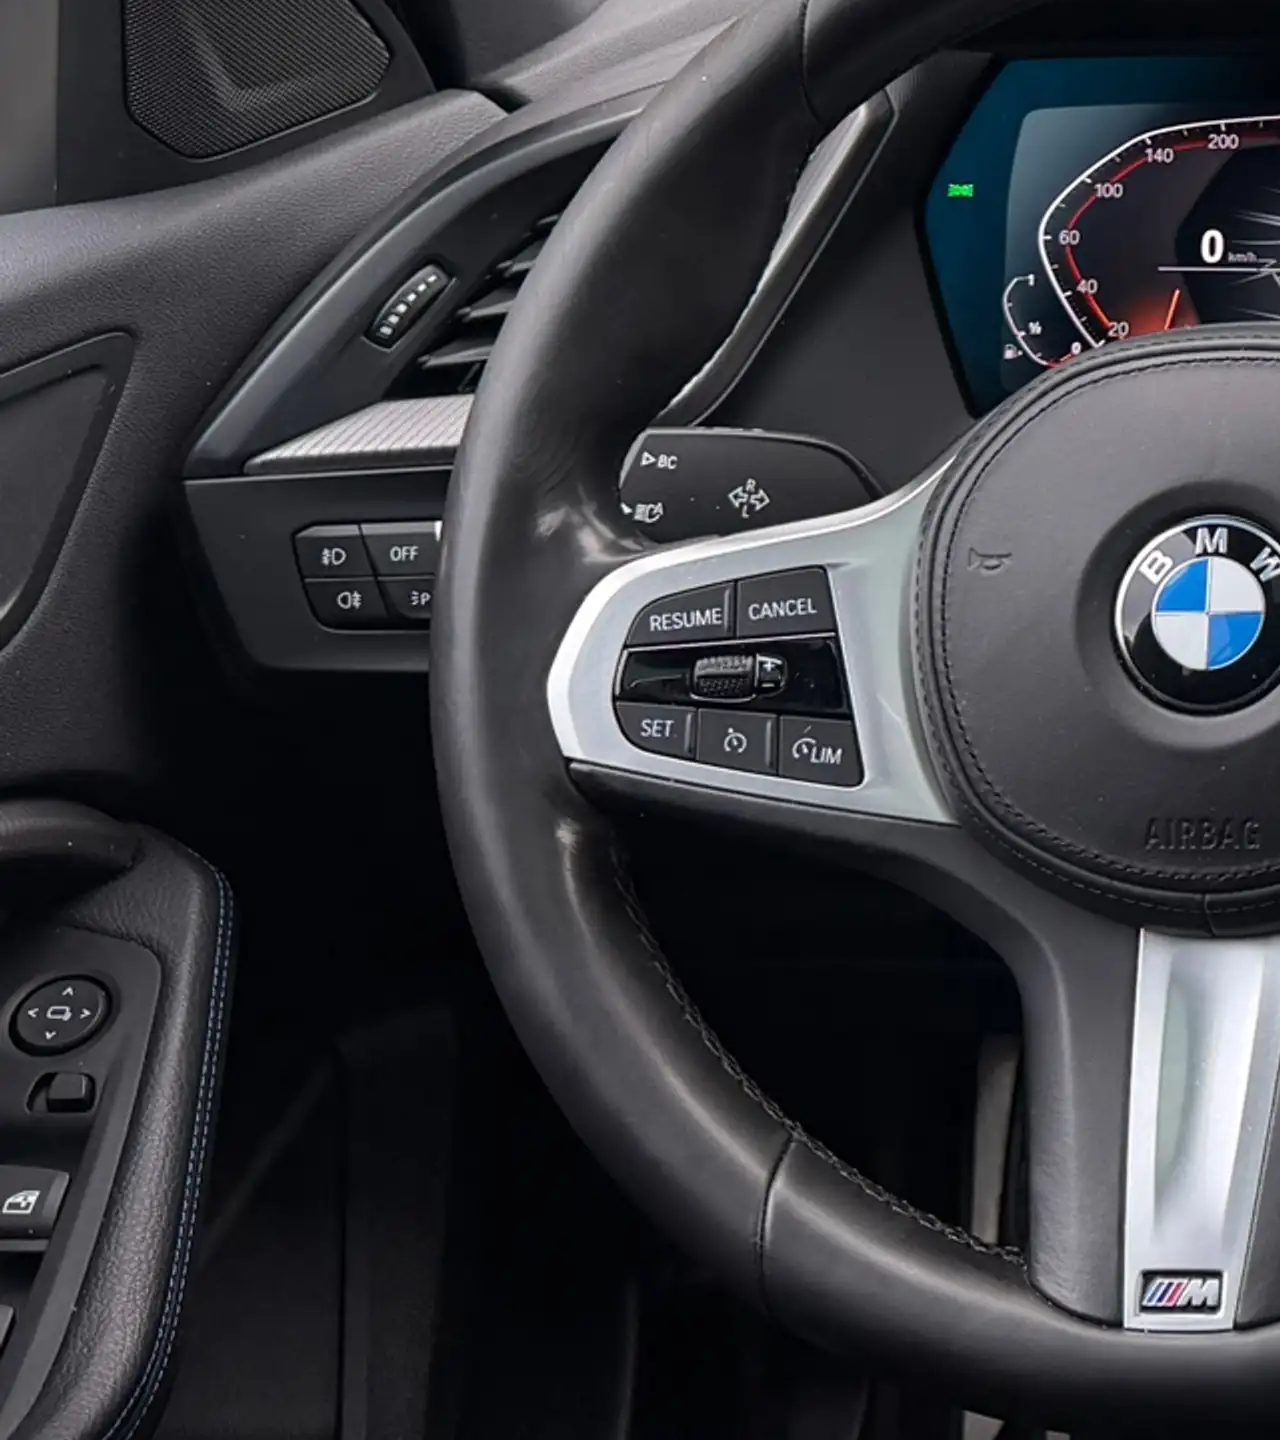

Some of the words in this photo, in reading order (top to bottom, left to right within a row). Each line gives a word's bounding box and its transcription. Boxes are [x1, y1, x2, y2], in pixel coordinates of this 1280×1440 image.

[1207, 133, 1240, 150] 200
[1145, 147, 1174, 164] 140
[1094, 182, 1124, 199] 100
[1058, 229, 1080, 246] 60
[1200, 228, 1225, 263] 0
[1076, 278, 1098, 295] 40
[1107, 321, 1130, 338] 20
[1071, 342, 1081, 355] 0
[657, 454, 678, 470] BC
[746, 478, 756, 492] R
[741, 503, 750, 518] L
[389, 545, 419, 562] OFF
[747, 598, 817, 620] CANCEL
[649, 607, 723, 632] RESUME
[640, 719, 674, 738] SET
[810, 745, 842, 765] LIM
[1144, 817, 1262, 852] AIRBAG
[1175, 1278, 1220, 1307] M
